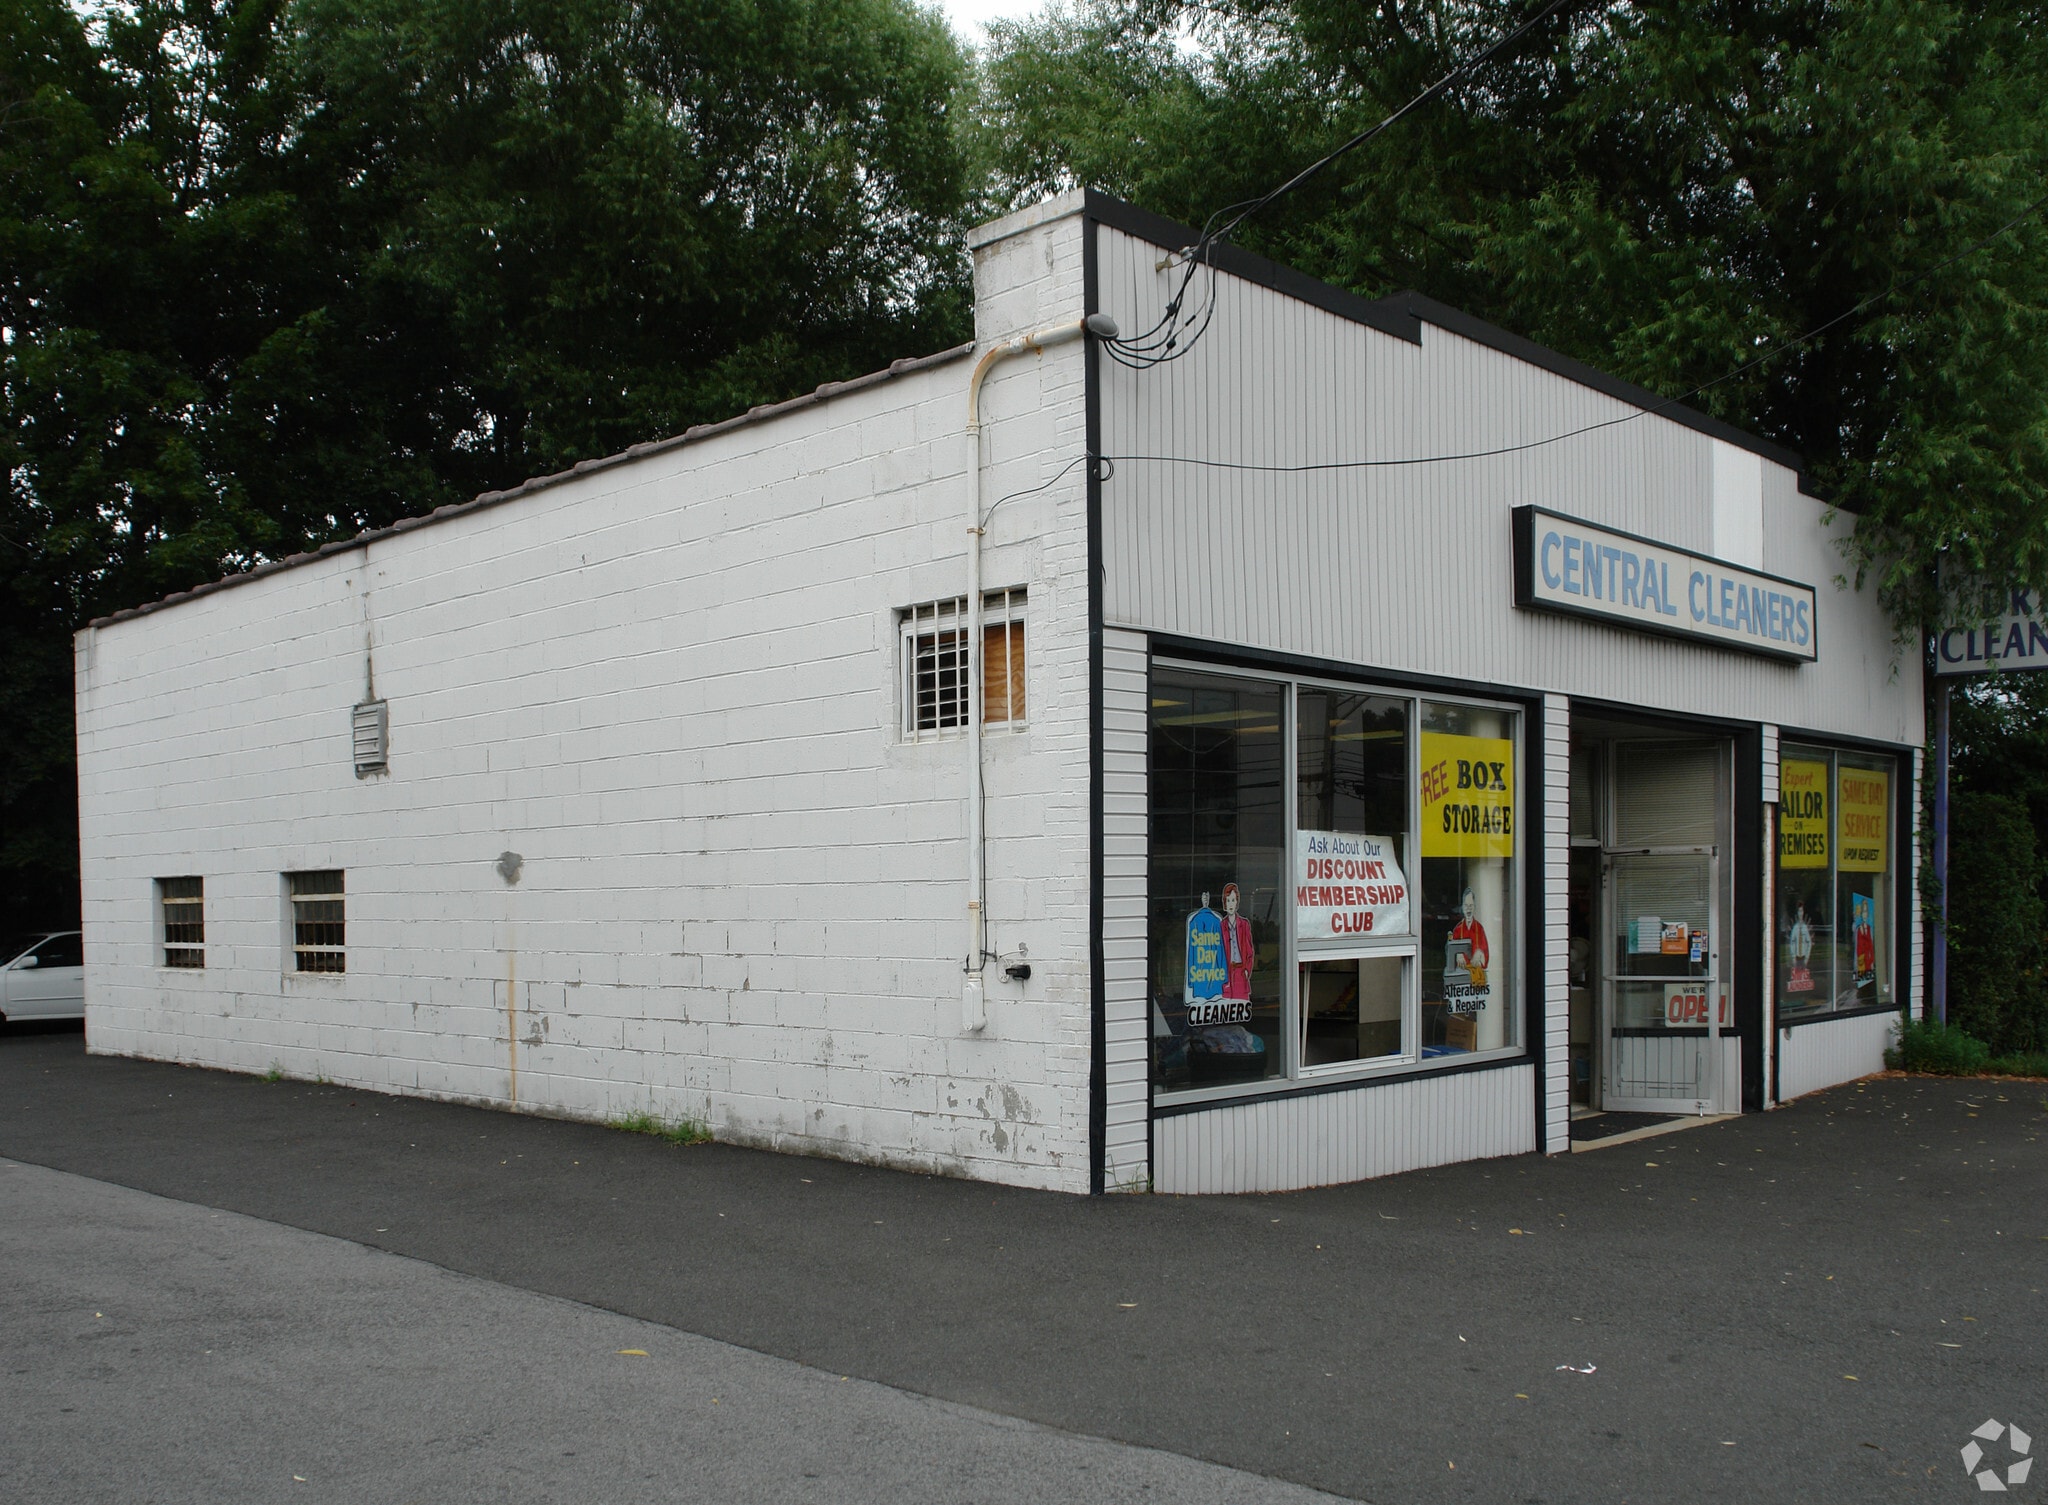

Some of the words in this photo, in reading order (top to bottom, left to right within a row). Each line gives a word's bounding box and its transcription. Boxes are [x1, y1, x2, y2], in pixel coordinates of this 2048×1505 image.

[1541, 531, 1677, 616] CENTRAL
[1688, 570, 1809, 646] CLEANERS
[1421, 760, 1449, 807] REE
[1457, 760, 1506, 791] BOX
[1784, 766, 1814, 788] Expert
[1842, 779, 1867, 805] SAME
[1868, 782, 1885, 806] DAY
[1780, 791, 1823, 819] AILOR
[1443, 804, 1511, 835] STORAGE
[1844, 813, 1881, 838] SERVICE
[1308, 836, 1328, 854] Ask
[1332, 838, 1360, 855] About
[1363, 840, 1381, 856] Our
[1780, 833, 1825, 856] REMISES
[1307, 858, 1386, 880] DISCOUNT
[1297, 885, 1405, 906] MEMBERSHIP
[1331, 911, 1374, 934] CLUB
[1191, 928, 1221, 946] Same
[1196, 946, 1218, 968] Day
[1190, 965, 1226, 982] Service
[1444, 983, 1490, 998] Alterations
[1188, 1003, 1252, 1025] CLEANERS
[1447, 1000, 1453, 1012] &
[1455, 997, 1486, 1015] Repairs
